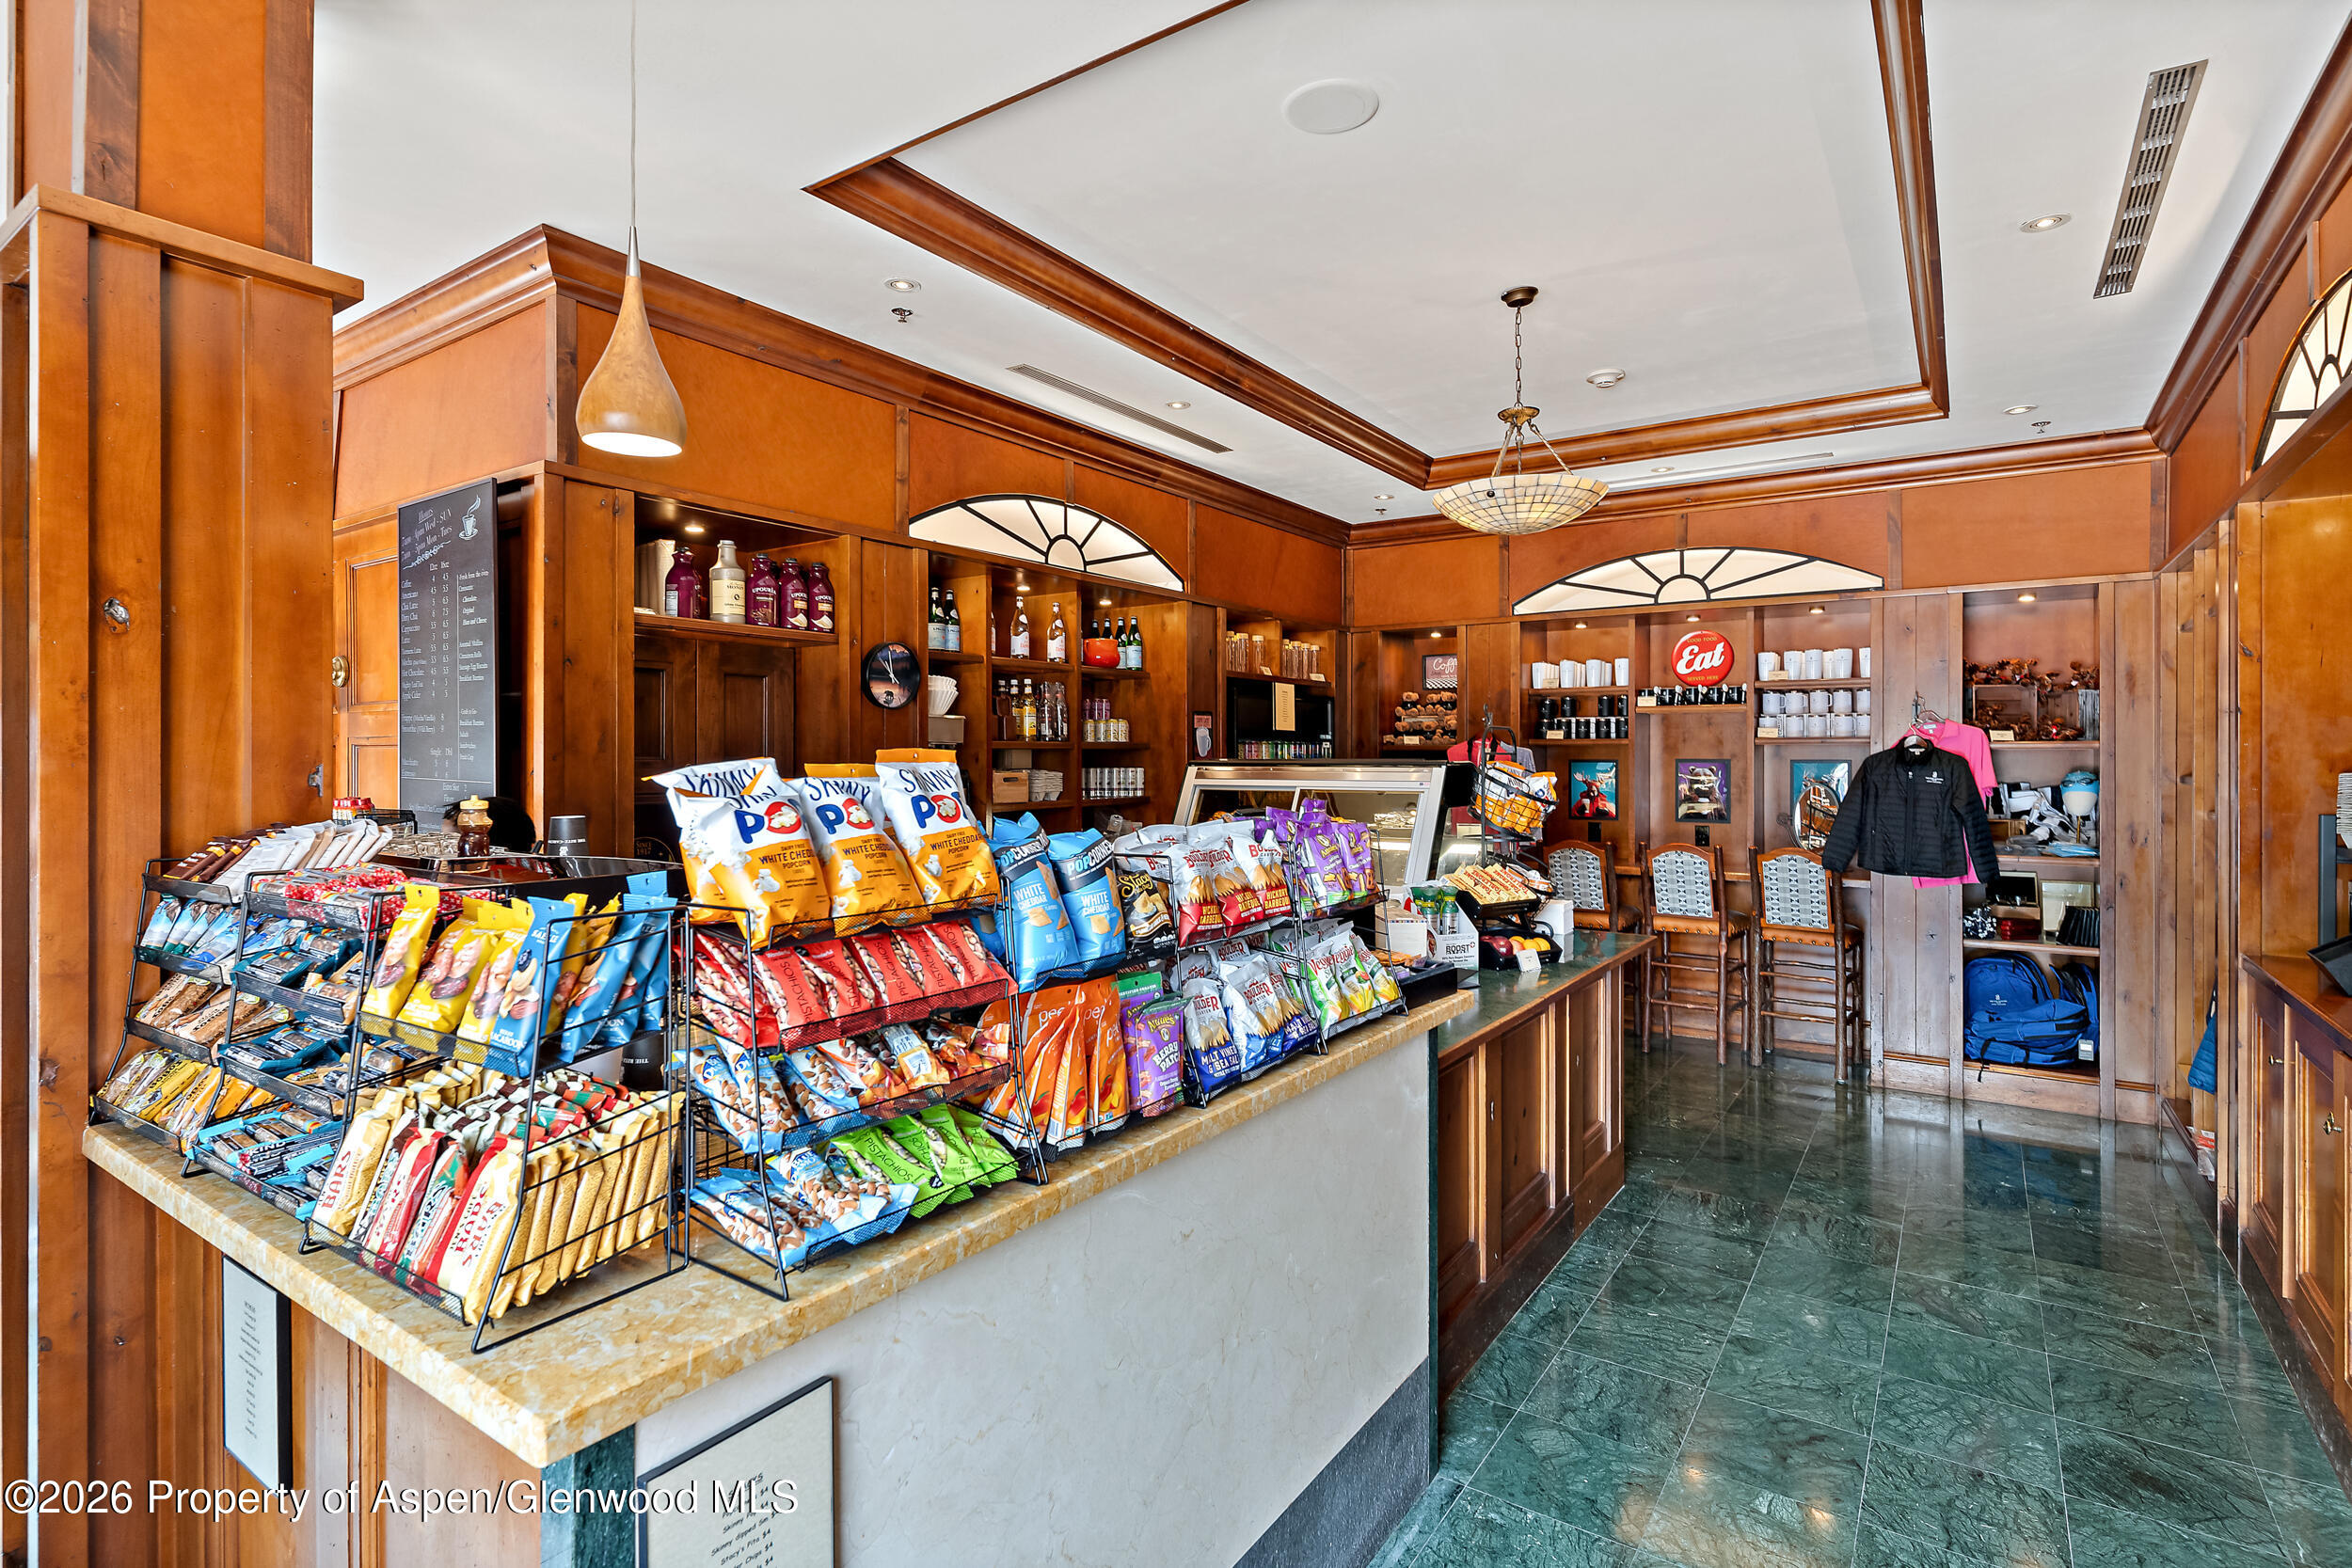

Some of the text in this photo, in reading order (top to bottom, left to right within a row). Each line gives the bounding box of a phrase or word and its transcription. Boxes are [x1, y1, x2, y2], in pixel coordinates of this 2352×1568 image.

[1433, 657, 1457, 674] Coff
[1677, 641, 1724, 674] Eat
[842, 845, 869, 856] WHITE
[930, 841, 952, 851] WHITE
[947, 846, 969, 854] POPCORN
[758, 851, 787, 864] WHITE
[782, 860, 811, 870] POPCORN
[1013, 882, 1045, 902] WHITE
[1081, 891, 1109, 907] WHITE
[1017, 895, 1048, 911] CHEDDAR
[1082, 904, 1110, 915] CHEDDAR
[874, 942, 909, 997] PISTACHIOS
[1152, 1041, 1179, 1066] BERRY
[1200, 1050, 1219, 1065] MALT
[1215, 1058, 1230, 1071] SEA
[249, 1141, 286, 1155] KIND
[865, 1136, 914, 1181] PISTACHIOS
[322, 1149, 351, 1210] BARS
[723, 1517, 744, 1534] Skinny
[711, 1539, 734, 1557] Skinny
[735, 1523, 756, 1542] dipped
[721, 1546, 745, 1566] Stacy's
[746, 1537, 760, 1549] Pita
[745, 1549, 762, 1564] Chips
